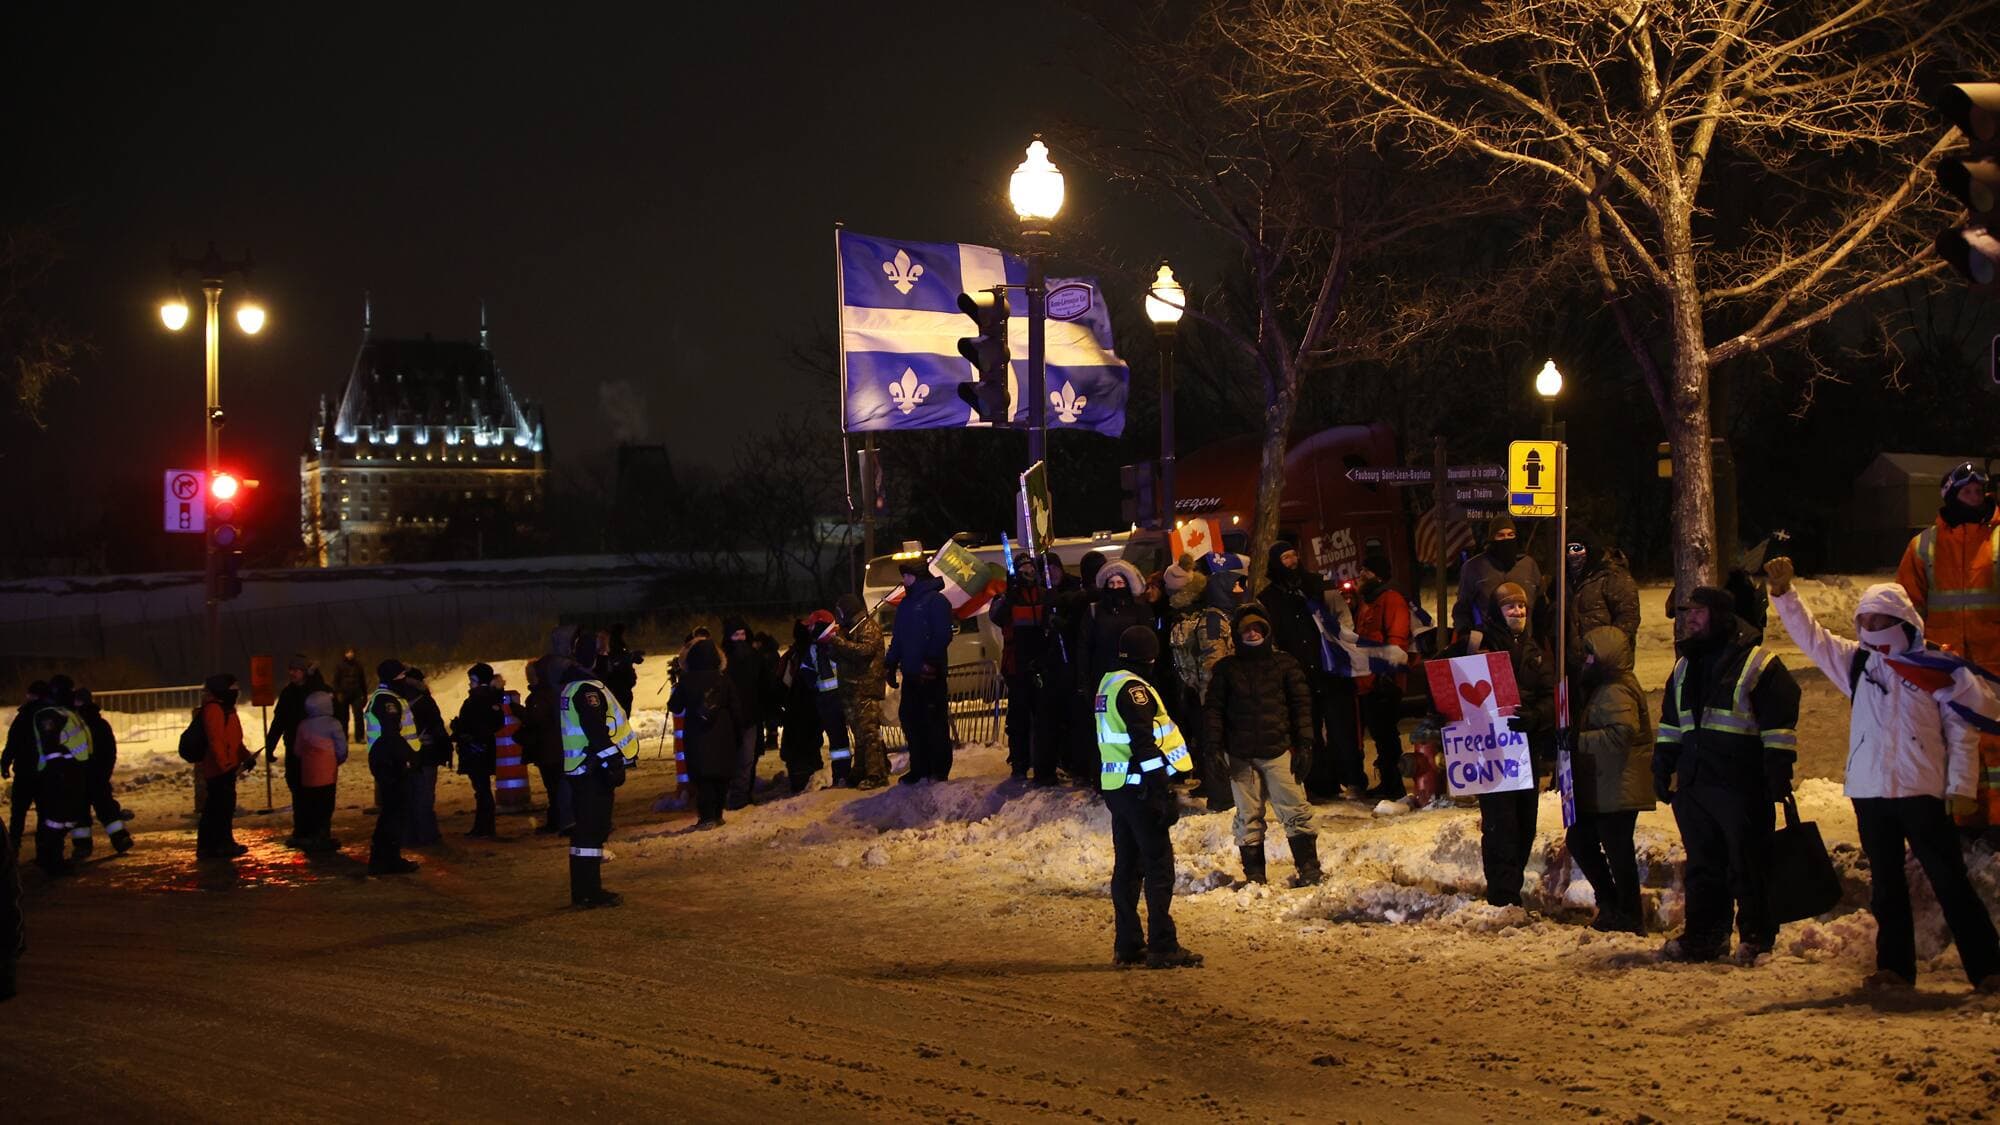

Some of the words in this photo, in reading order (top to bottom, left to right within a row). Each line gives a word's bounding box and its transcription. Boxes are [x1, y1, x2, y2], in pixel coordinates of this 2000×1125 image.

[1355, 470, 1380, 482] Faubourg
[1382, 469, 1431, 481] Saint-Jean-Baptiste
[1472, 468, 1477, 478] de
[1456, 489, 1471, 500] Grand
[1521, 505, 1543, 515] 2271
[1312, 528, 1354, 556] FCK
[1316, 545, 1357, 567] TRUDEAU
